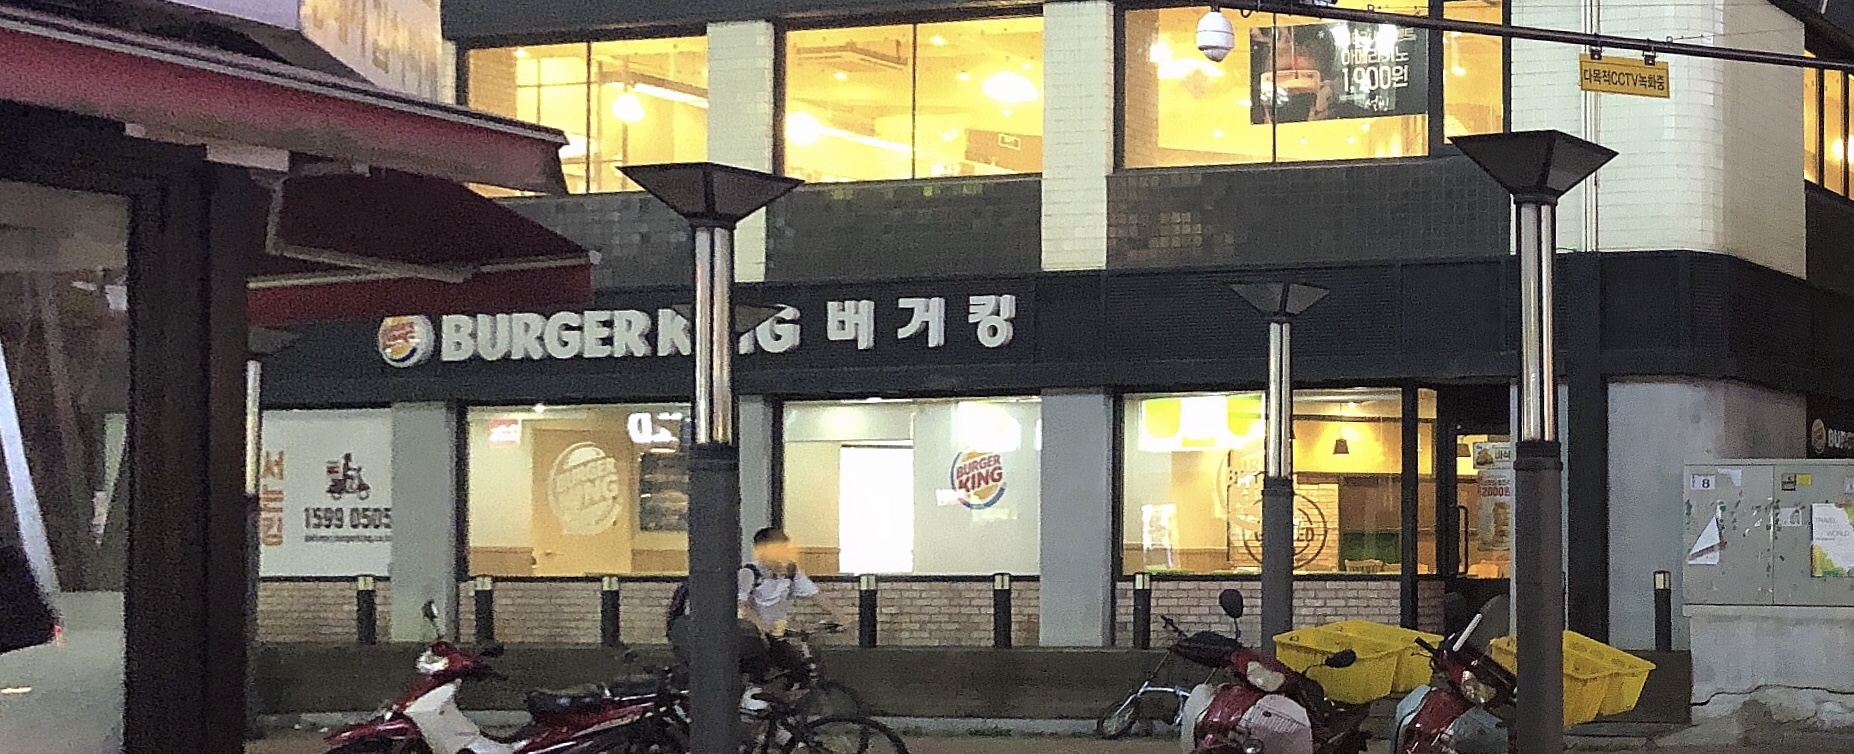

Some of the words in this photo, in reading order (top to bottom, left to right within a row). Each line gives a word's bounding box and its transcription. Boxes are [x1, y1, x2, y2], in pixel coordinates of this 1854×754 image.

[1341, 65, 1409, 93] 1,900원
[1583, 68, 1665, 91] 다목적CCTV녹화중
[441, 309, 651, 361] BURGER
[657, 304, 801, 356] KG
[956, 454, 1001, 480] BURGER
[958, 466, 1003, 493] KING
[1702, 479, 1709, 489] 8
[304, 507, 344, 529] 1599
[350, 507, 392, 529] 0505
